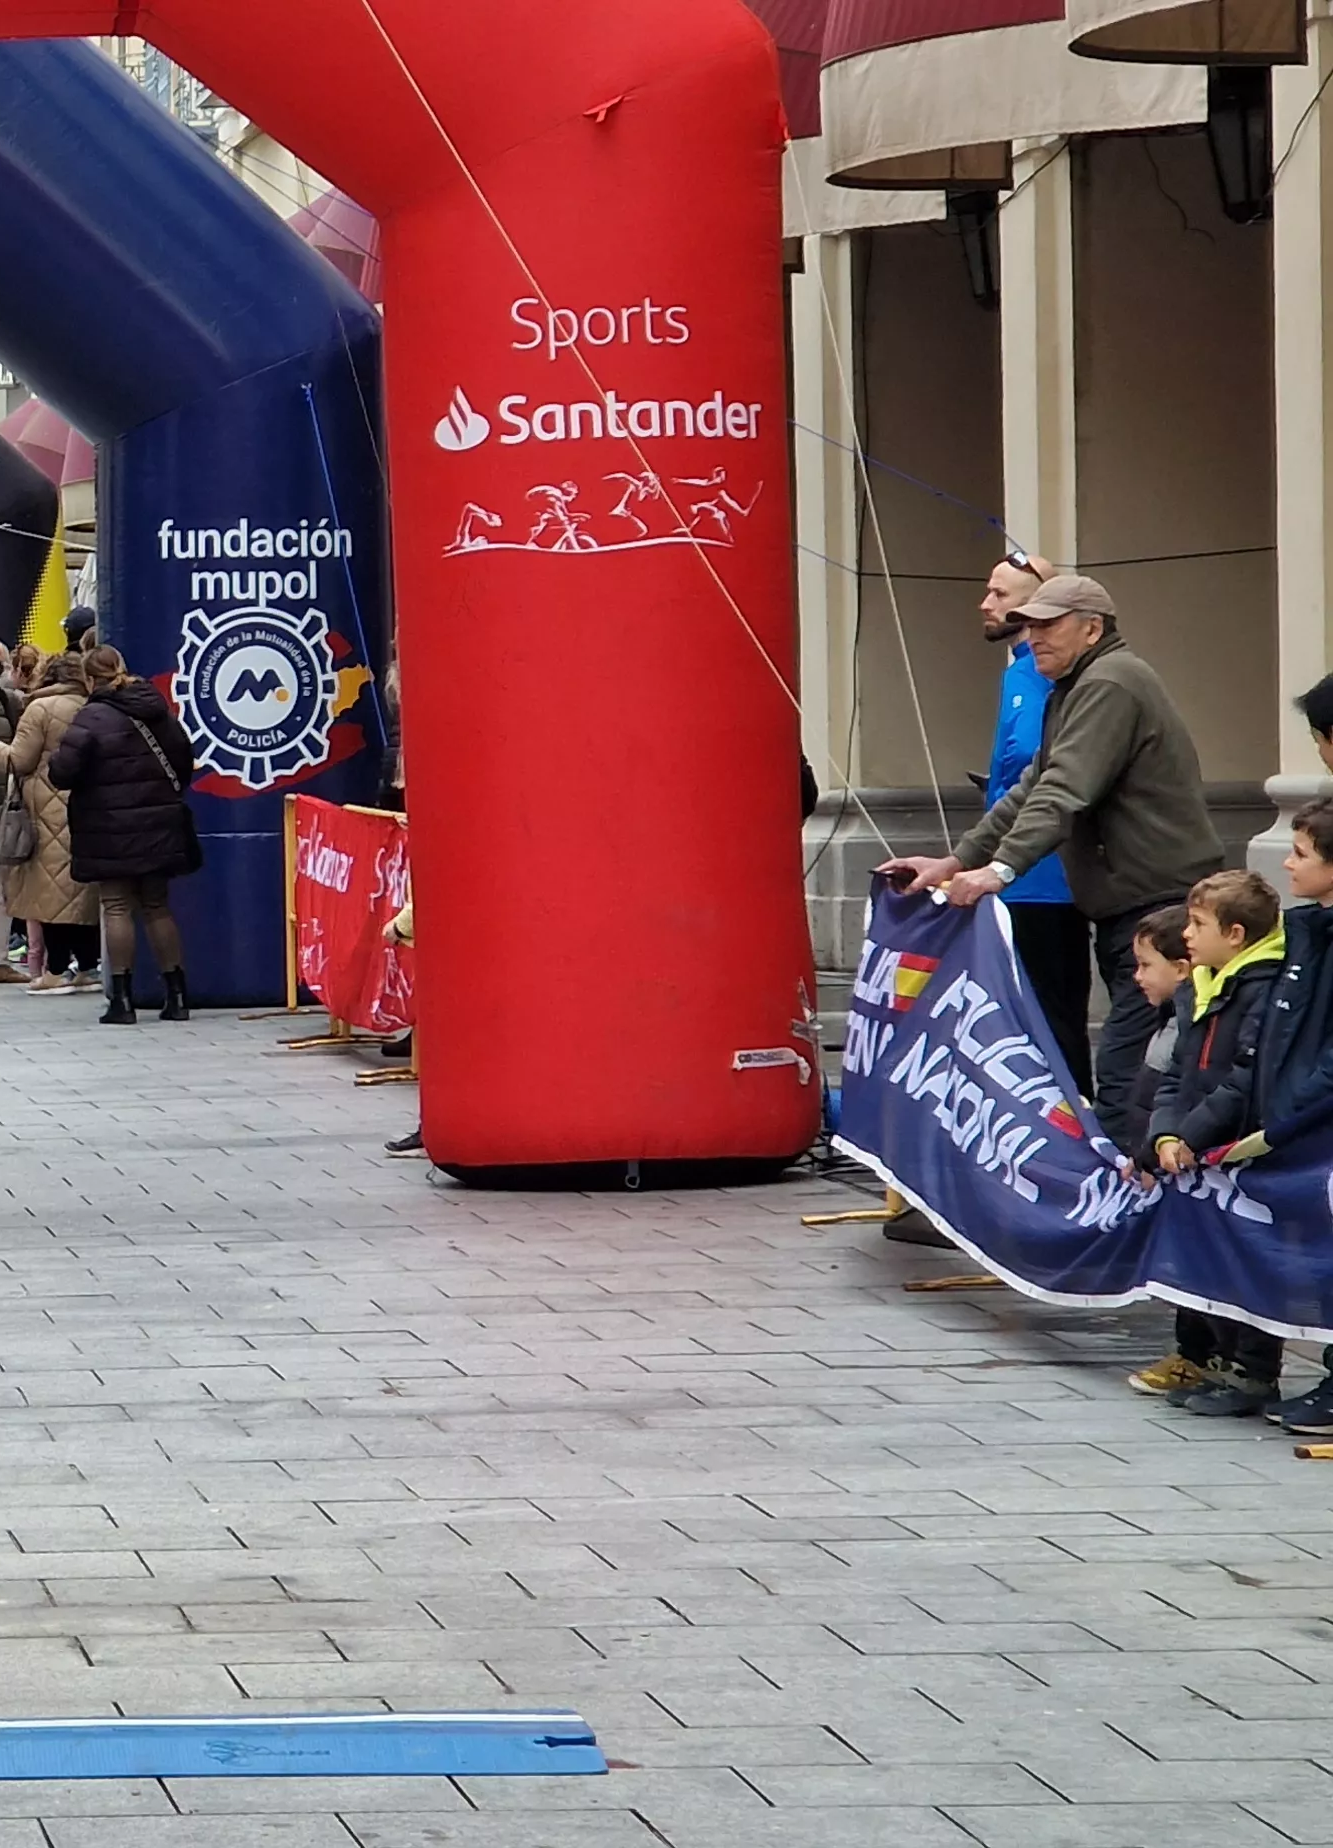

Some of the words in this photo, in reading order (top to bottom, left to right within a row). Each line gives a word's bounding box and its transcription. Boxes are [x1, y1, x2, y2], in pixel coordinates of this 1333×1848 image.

[510, 296, 690, 361] Sports
[498, 389, 763, 444] Santander
[157, 517, 353, 559] fundación
[191, 560, 317, 608] mupol
[200, 645, 227, 699] Fundación
[226, 636, 240, 648] de
[241, 631, 252, 642] la
[255, 630, 308, 668] Mutualidad
[301, 669, 312, 684] de
[227, 728, 288, 747] POLICÍA
